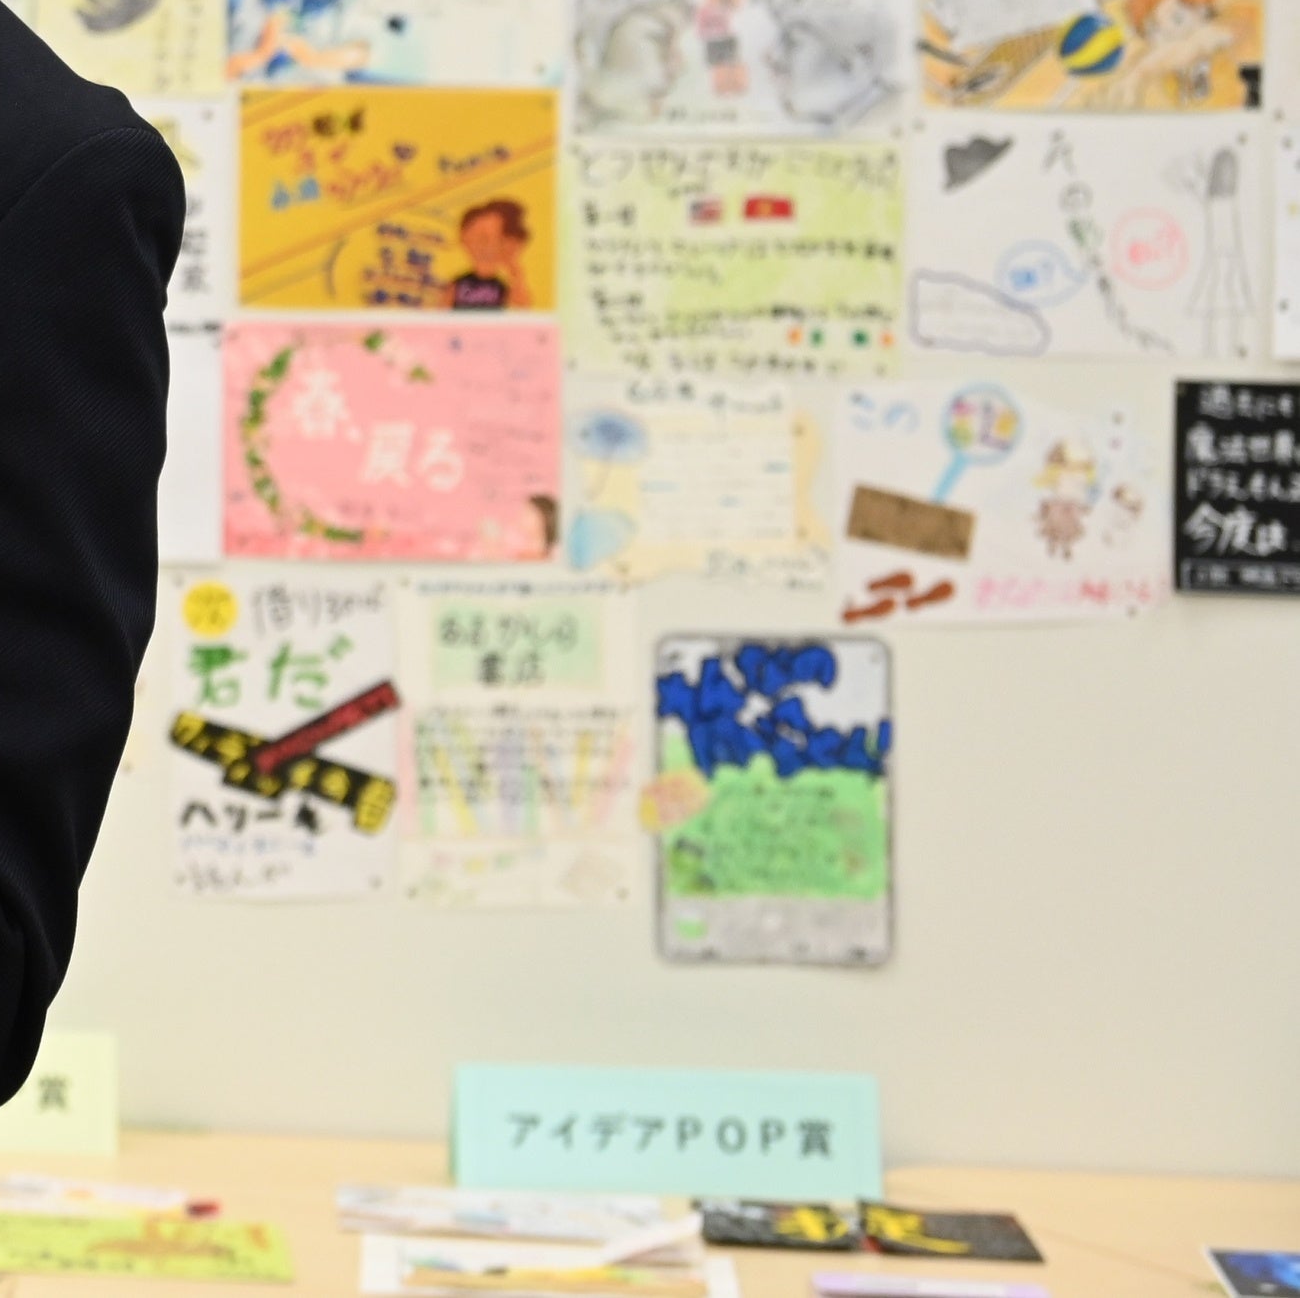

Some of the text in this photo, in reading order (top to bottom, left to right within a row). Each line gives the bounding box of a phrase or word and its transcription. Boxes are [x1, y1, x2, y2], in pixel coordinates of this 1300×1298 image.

[360, 420, 463, 491] 戻る
[187, 634, 354, 709] 君だ
[506, 1110, 836, 1159] アイデアPOP賞
